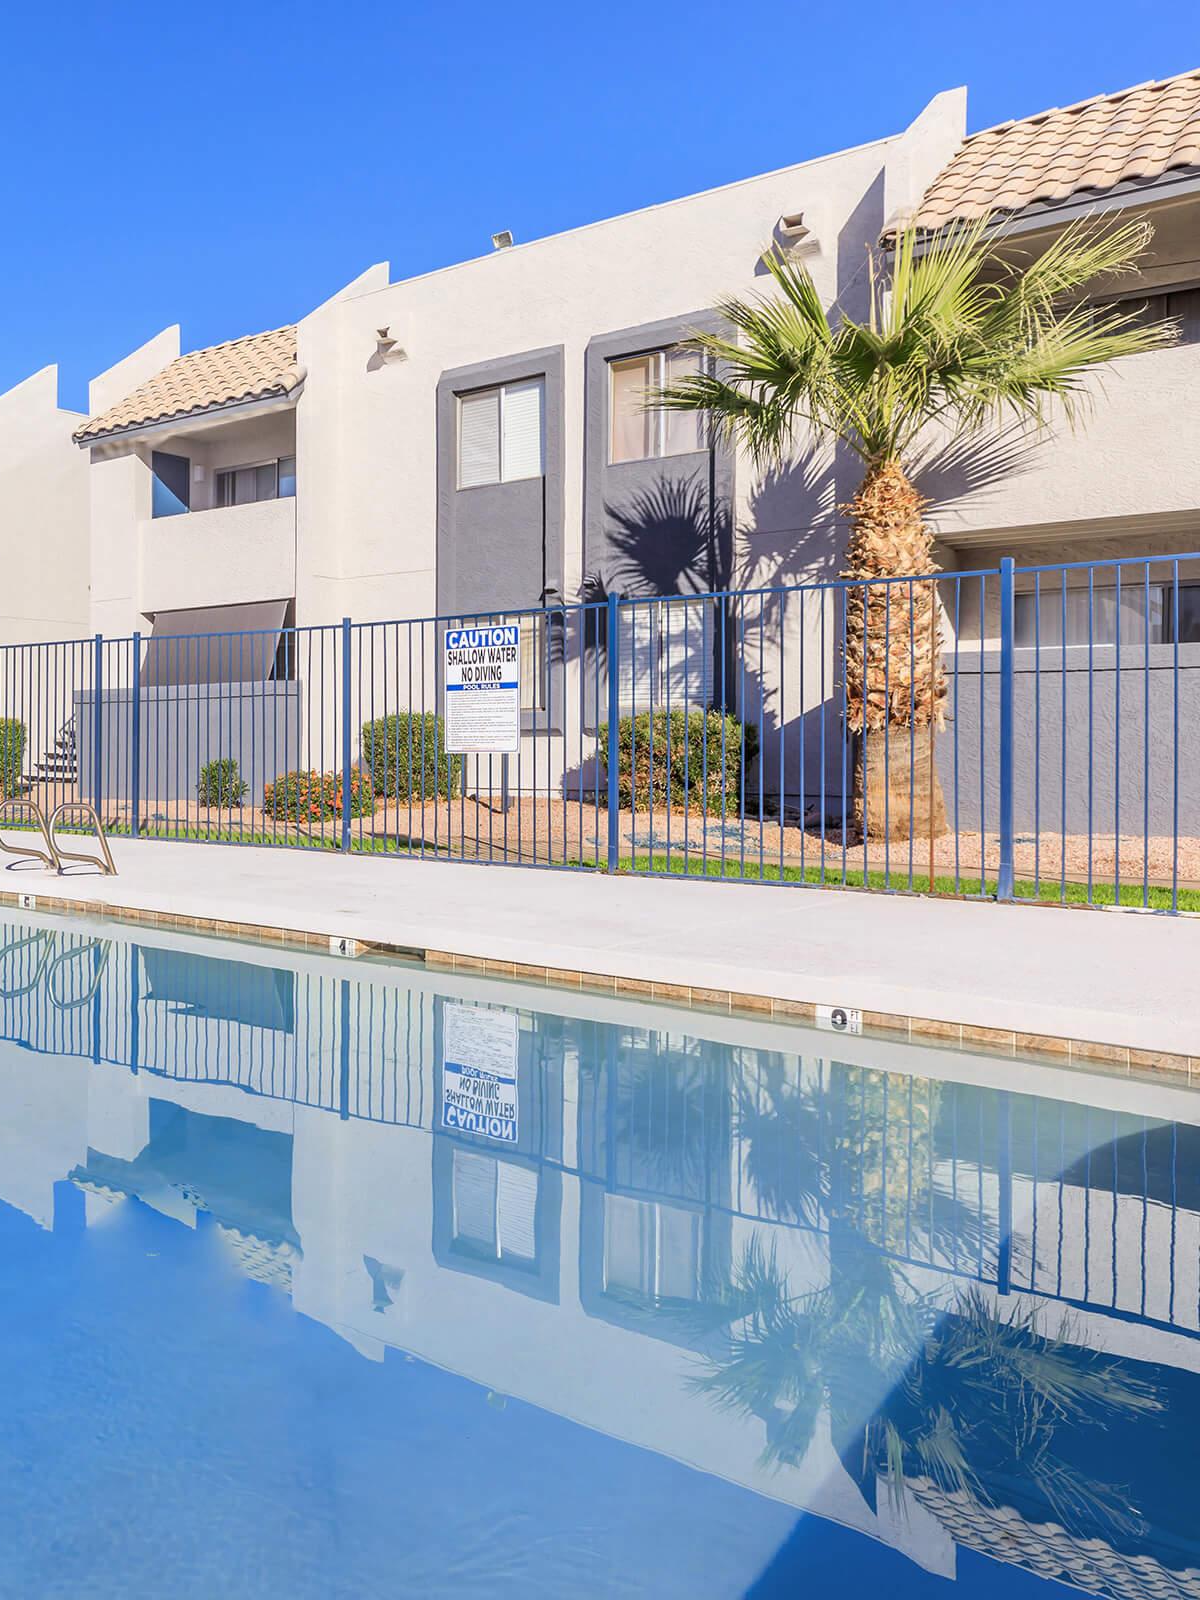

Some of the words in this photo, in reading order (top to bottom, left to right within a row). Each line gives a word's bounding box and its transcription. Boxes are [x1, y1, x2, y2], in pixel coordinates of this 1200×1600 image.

[448, 628, 516, 649] CAUTION
[447, 649, 486, 666] SHALLOW
[488, 646, 517, 664] WATER
[461, 667, 473, 682] NO
[474, 665, 502, 682] DIVING
[463, 683, 480, 691] POOL
[481, 682, 501, 690] RULES
